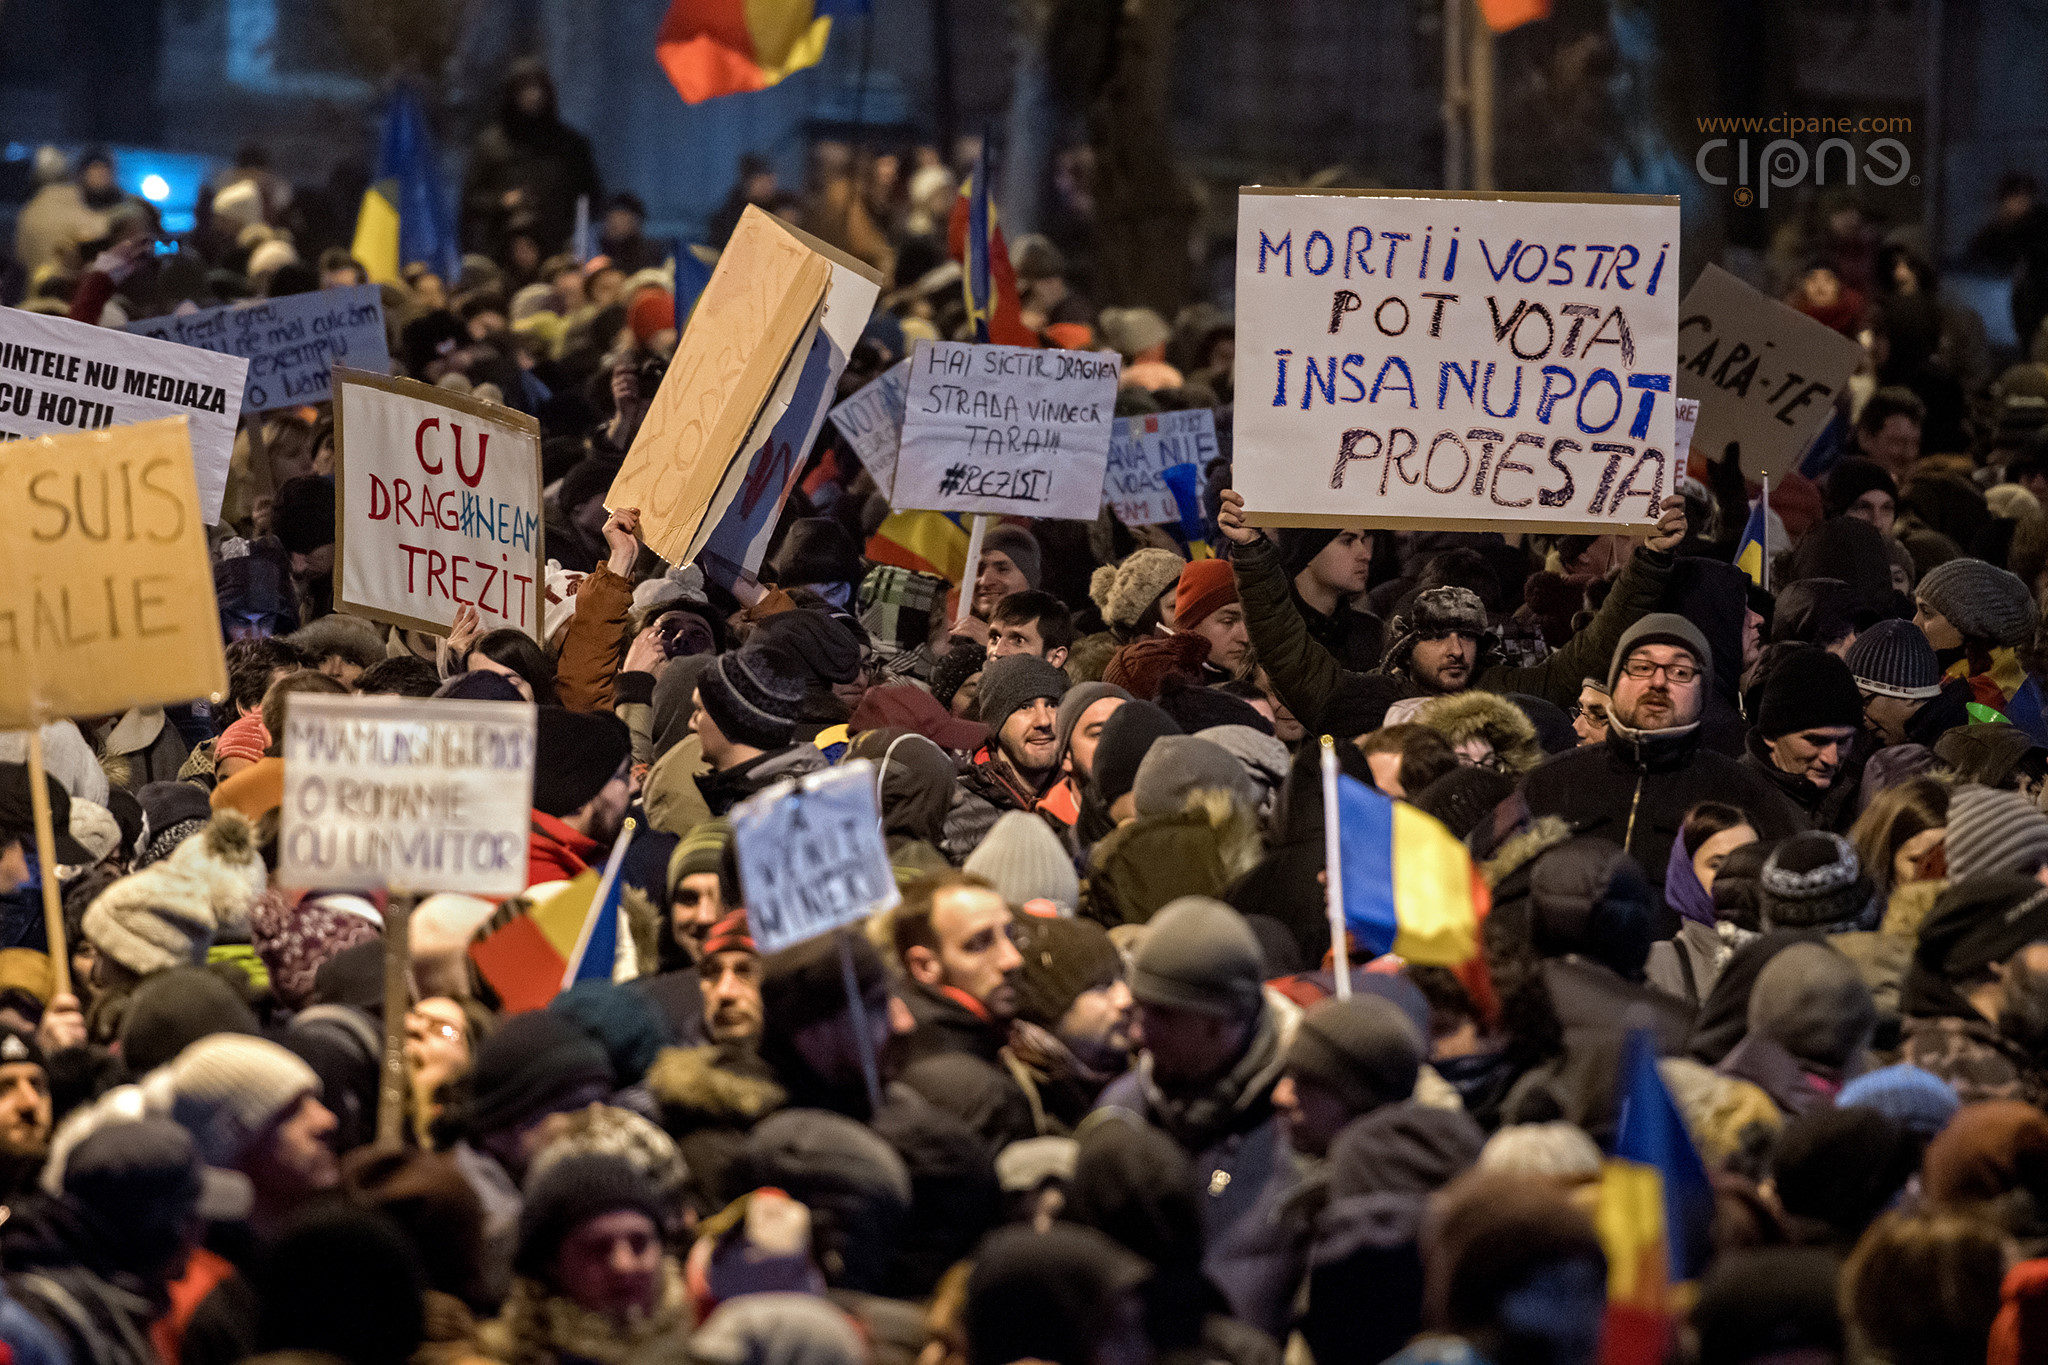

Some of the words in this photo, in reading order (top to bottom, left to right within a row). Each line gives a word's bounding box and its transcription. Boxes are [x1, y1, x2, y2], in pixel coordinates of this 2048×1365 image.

[1328, 289, 1459, 339] POT
[1485, 296, 1636, 368] VOTA
[0, 342, 80, 383] INTELE
[84, 361, 118, 390] NU
[123, 368, 226, 415] MEDIAZA
[922, 385, 1020, 422] STRADA
[1056, 354, 1118, 381] DRAGNEA
[1437, 360, 1523, 419] NU
[1536, 364, 1672, 441] POT
[0, 382, 33, 417] CU
[37, 391, 114, 430] HOTII
[415, 417, 490, 488] CU
[1329, 427, 1667, 520] PROTESTA
[28, 457, 186, 544] SUIS
